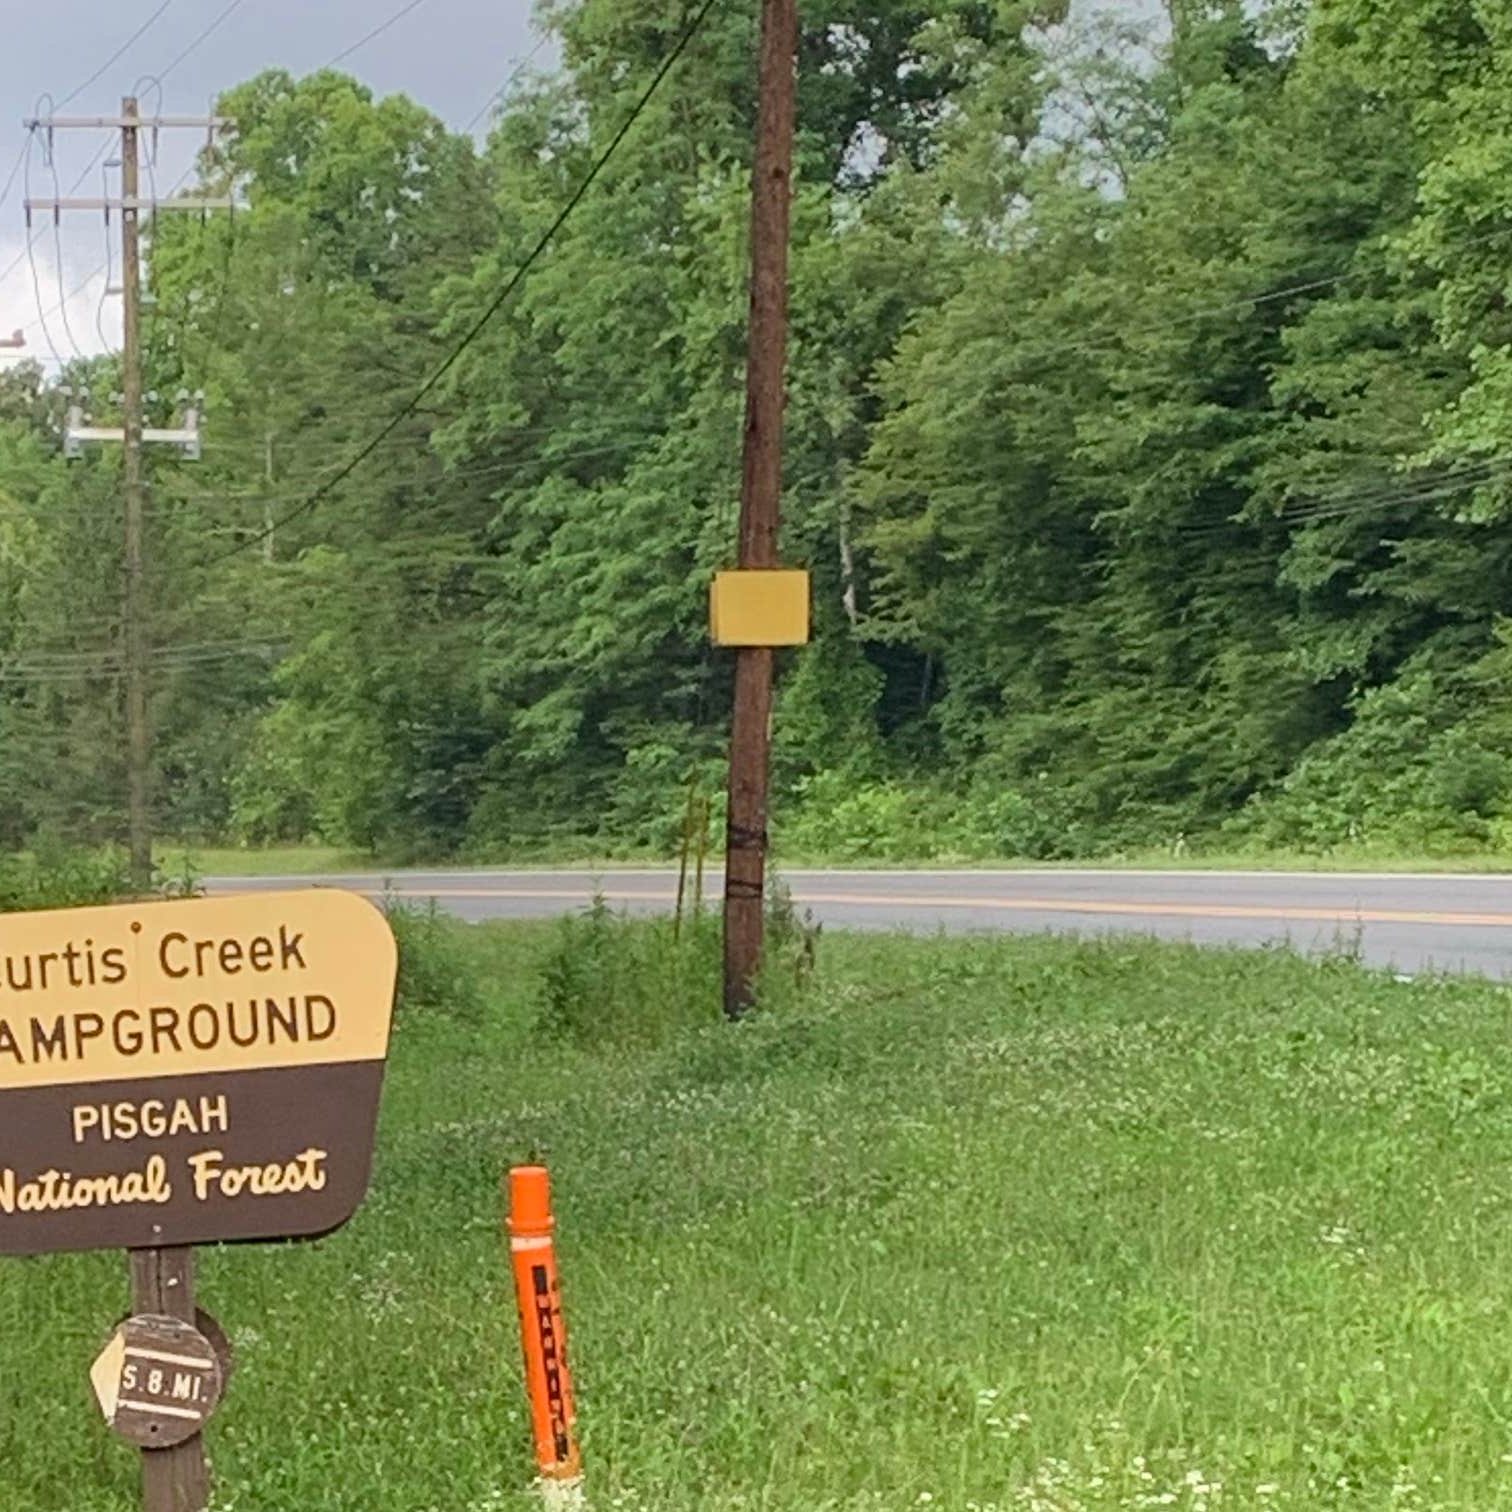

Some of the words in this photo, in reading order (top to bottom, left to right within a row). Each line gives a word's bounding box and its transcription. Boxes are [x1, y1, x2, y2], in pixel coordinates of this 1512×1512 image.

[159, 924, 307, 979] Creek
[73, 1095, 228, 1143] PISGAH
[187, 1148, 328, 1201] Forest
